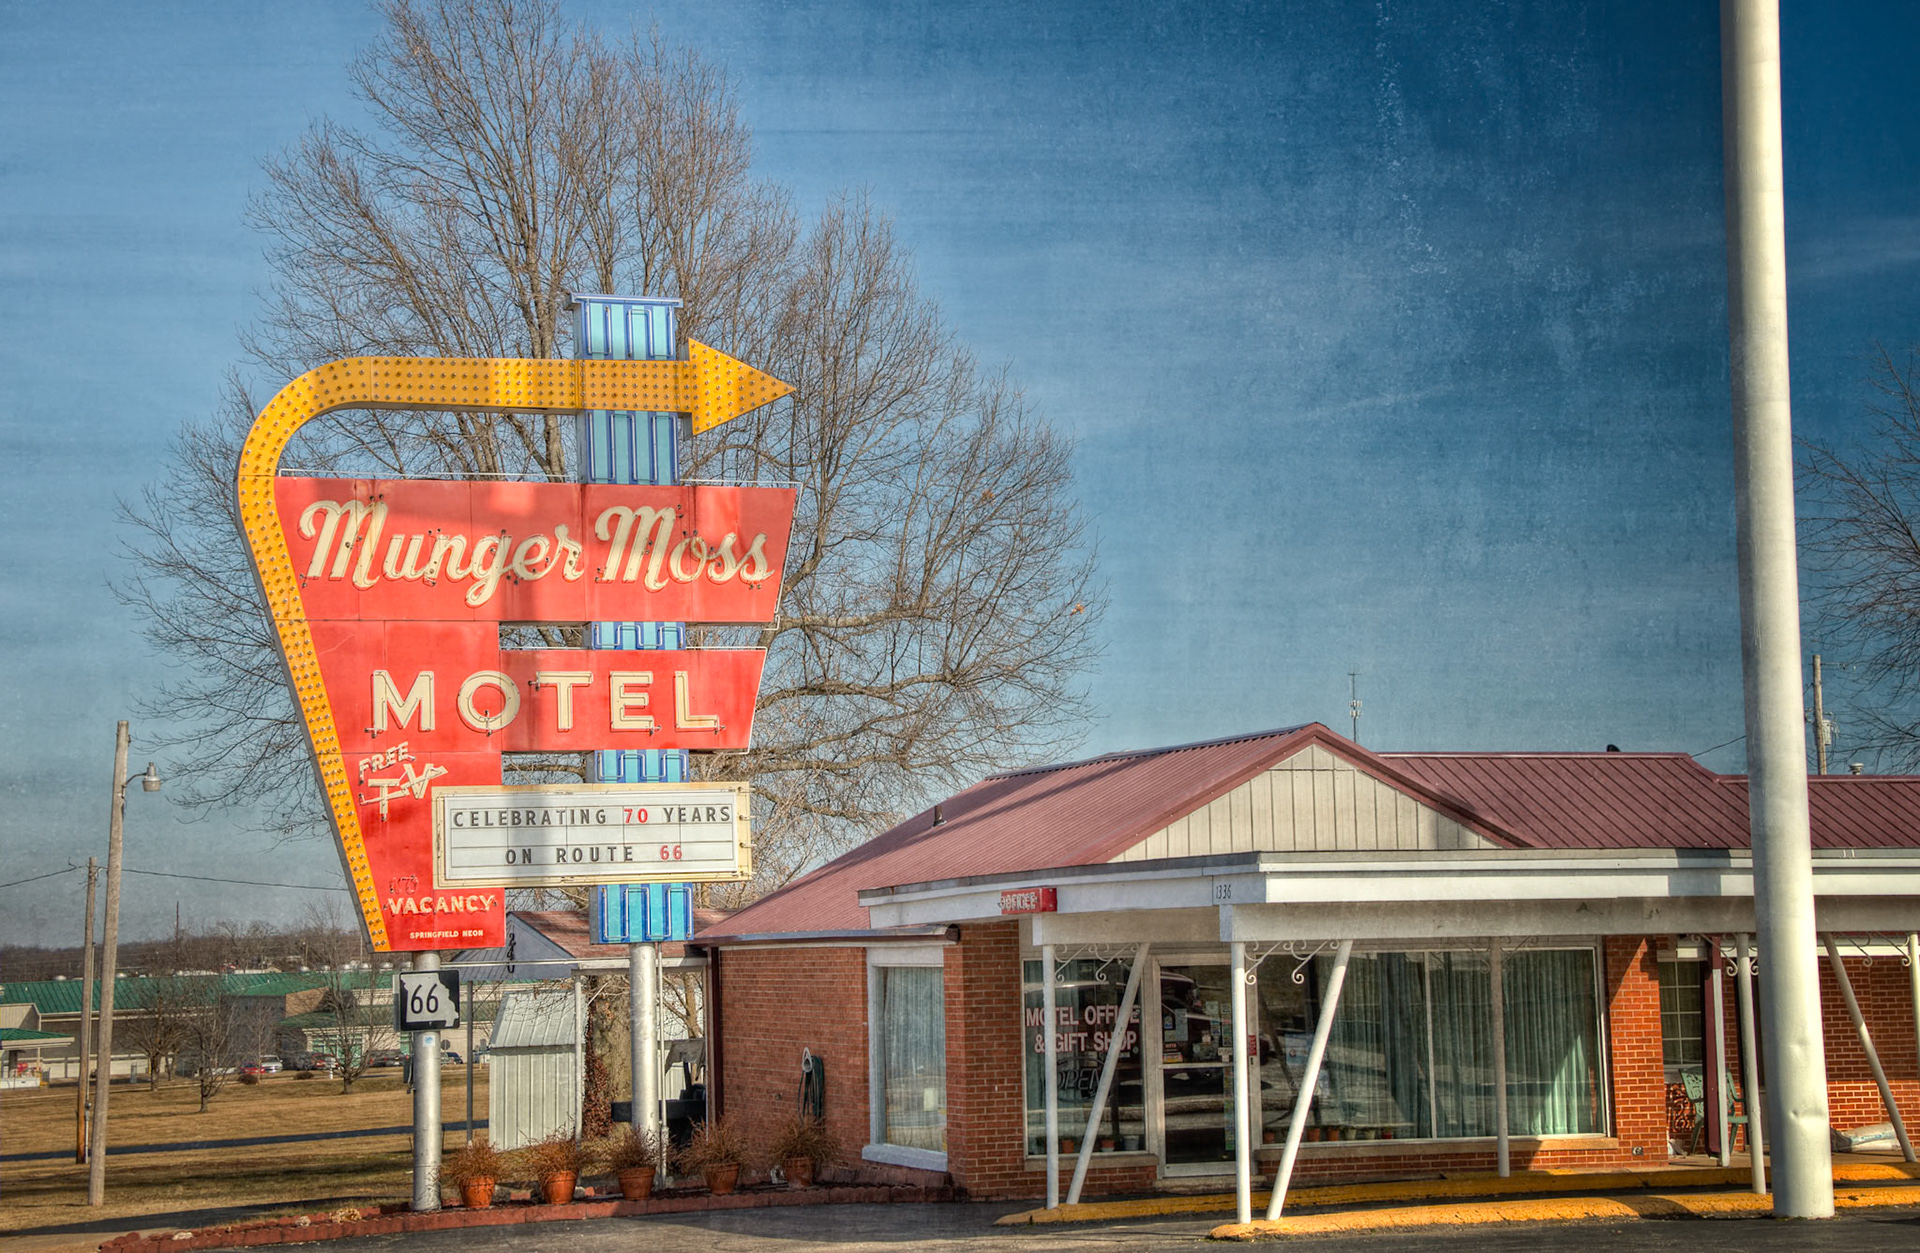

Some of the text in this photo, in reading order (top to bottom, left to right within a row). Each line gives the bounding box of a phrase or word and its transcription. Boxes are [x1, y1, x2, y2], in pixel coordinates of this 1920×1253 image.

[299, 500, 774, 606] Munger Moss
[372, 670, 721, 732] MOTEL
[359, 741, 408, 782] FREE
[362, 763, 446, 821] TV
[453, 806, 731, 827] CELEBRATING 70 YEARS
[505, 844, 683, 865] ON ROUTE 66
[1216, 884, 1231, 899] 1336
[387, 895, 495, 915] VACANCY
[410, 929, 484, 939] SPRINGFIELD NEON
[411, 983, 438, 1014] 66
[1084, 1005, 1140, 1025] OFFIE
[1056, 1032, 1088, 1052] GIFT
